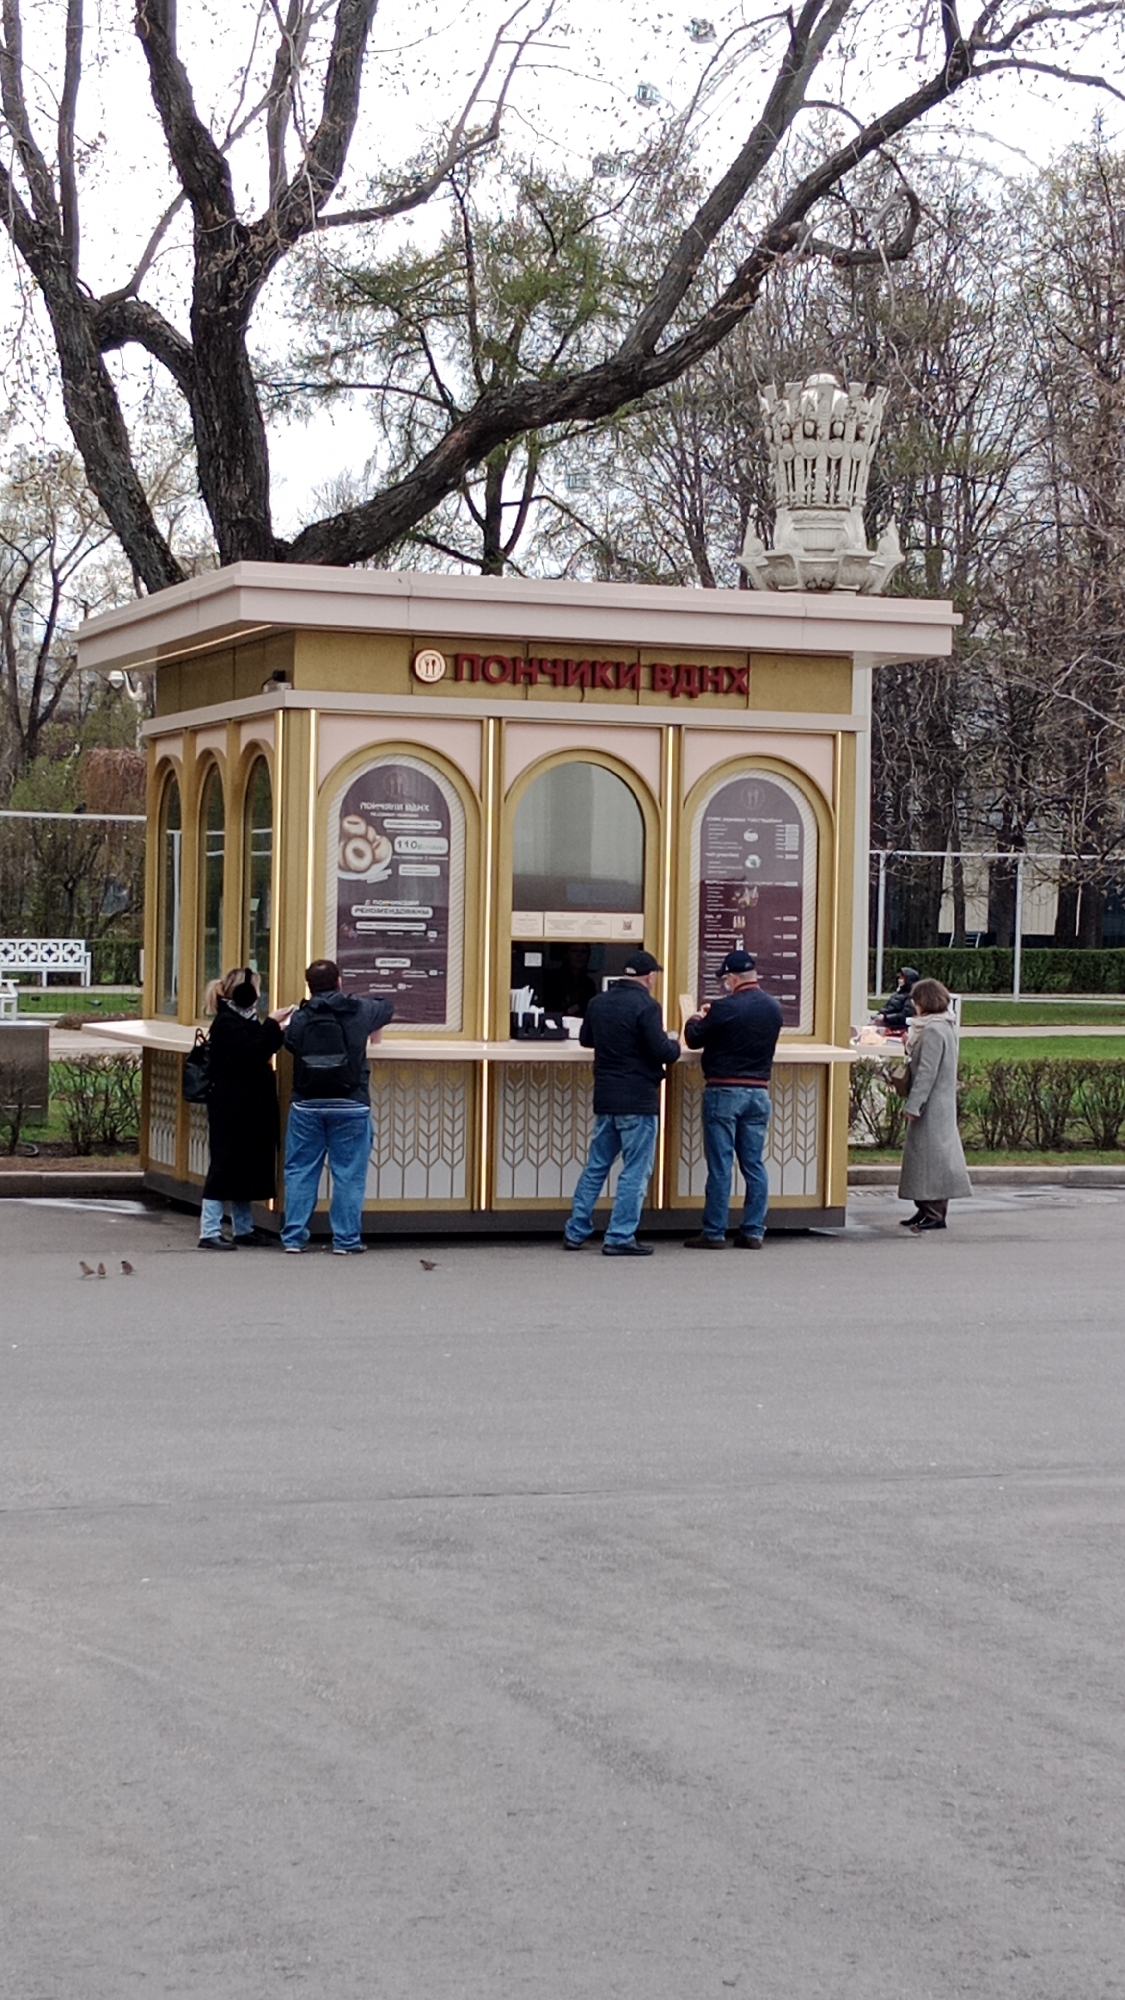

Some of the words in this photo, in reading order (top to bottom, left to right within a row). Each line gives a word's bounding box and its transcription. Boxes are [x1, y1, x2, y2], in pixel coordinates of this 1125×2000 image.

[455, 653, 640, 690] ПОНЧИКИ
[651, 662, 750, 699] ВДНХ
[397, 840, 418, 850] 110
